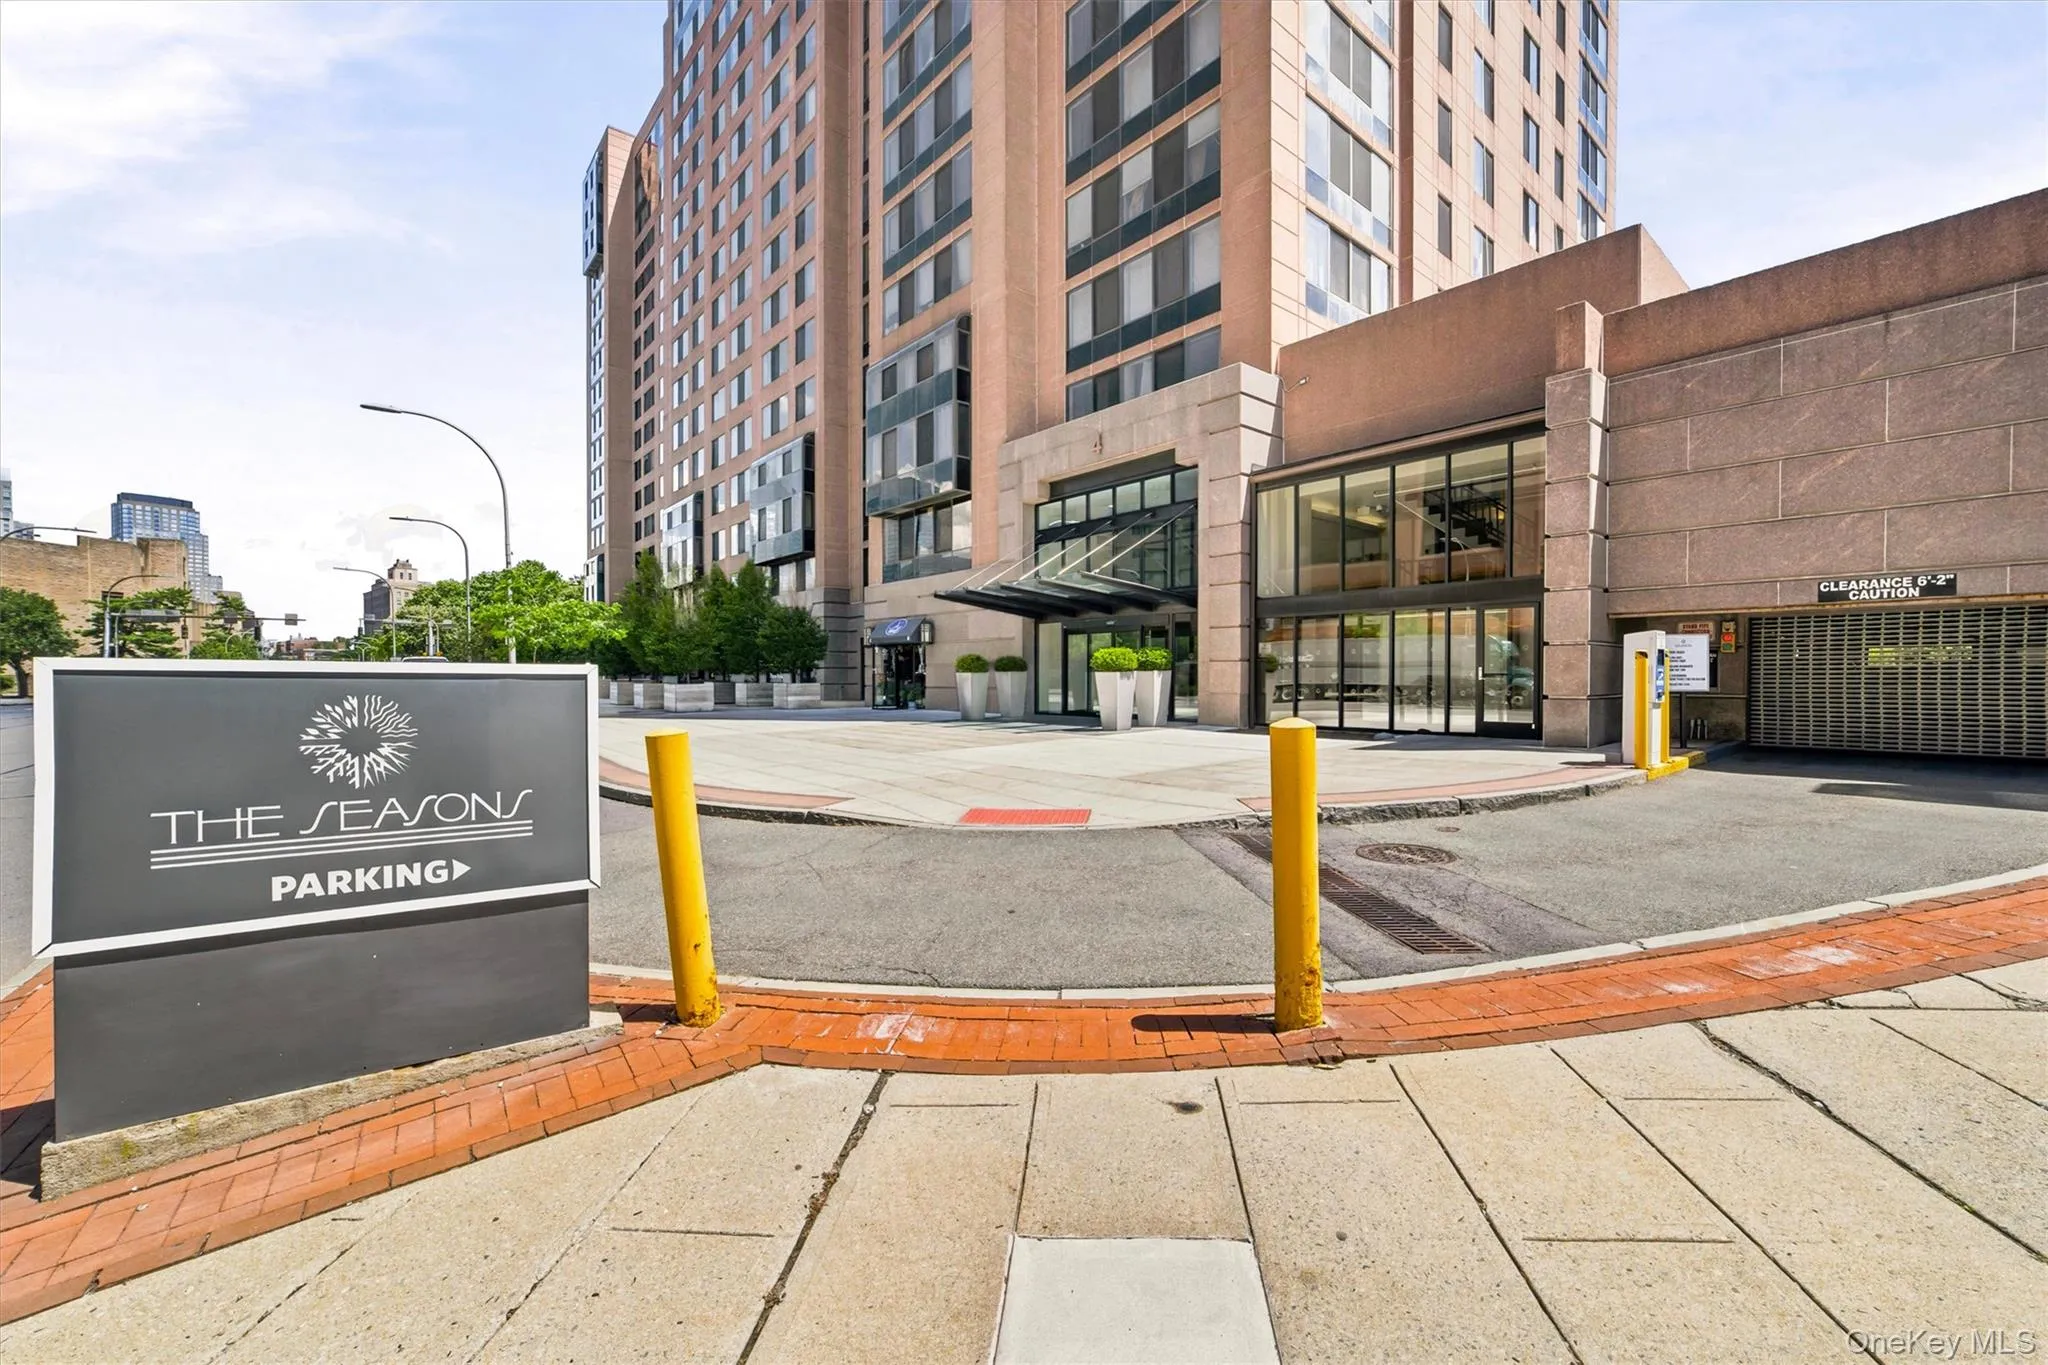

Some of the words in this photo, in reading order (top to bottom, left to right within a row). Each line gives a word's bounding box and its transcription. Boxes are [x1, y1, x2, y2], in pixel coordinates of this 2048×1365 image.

[1819, 576, 1913, 592] CLEARANCE
[1917, 573, 1955, 587] 6'-2"
[1848, 586, 1920, 601] CAUTION
[150, 804, 284, 845] THE
[299, 788, 534, 836] SEASONS
[271, 859, 449, 902] PARKING
